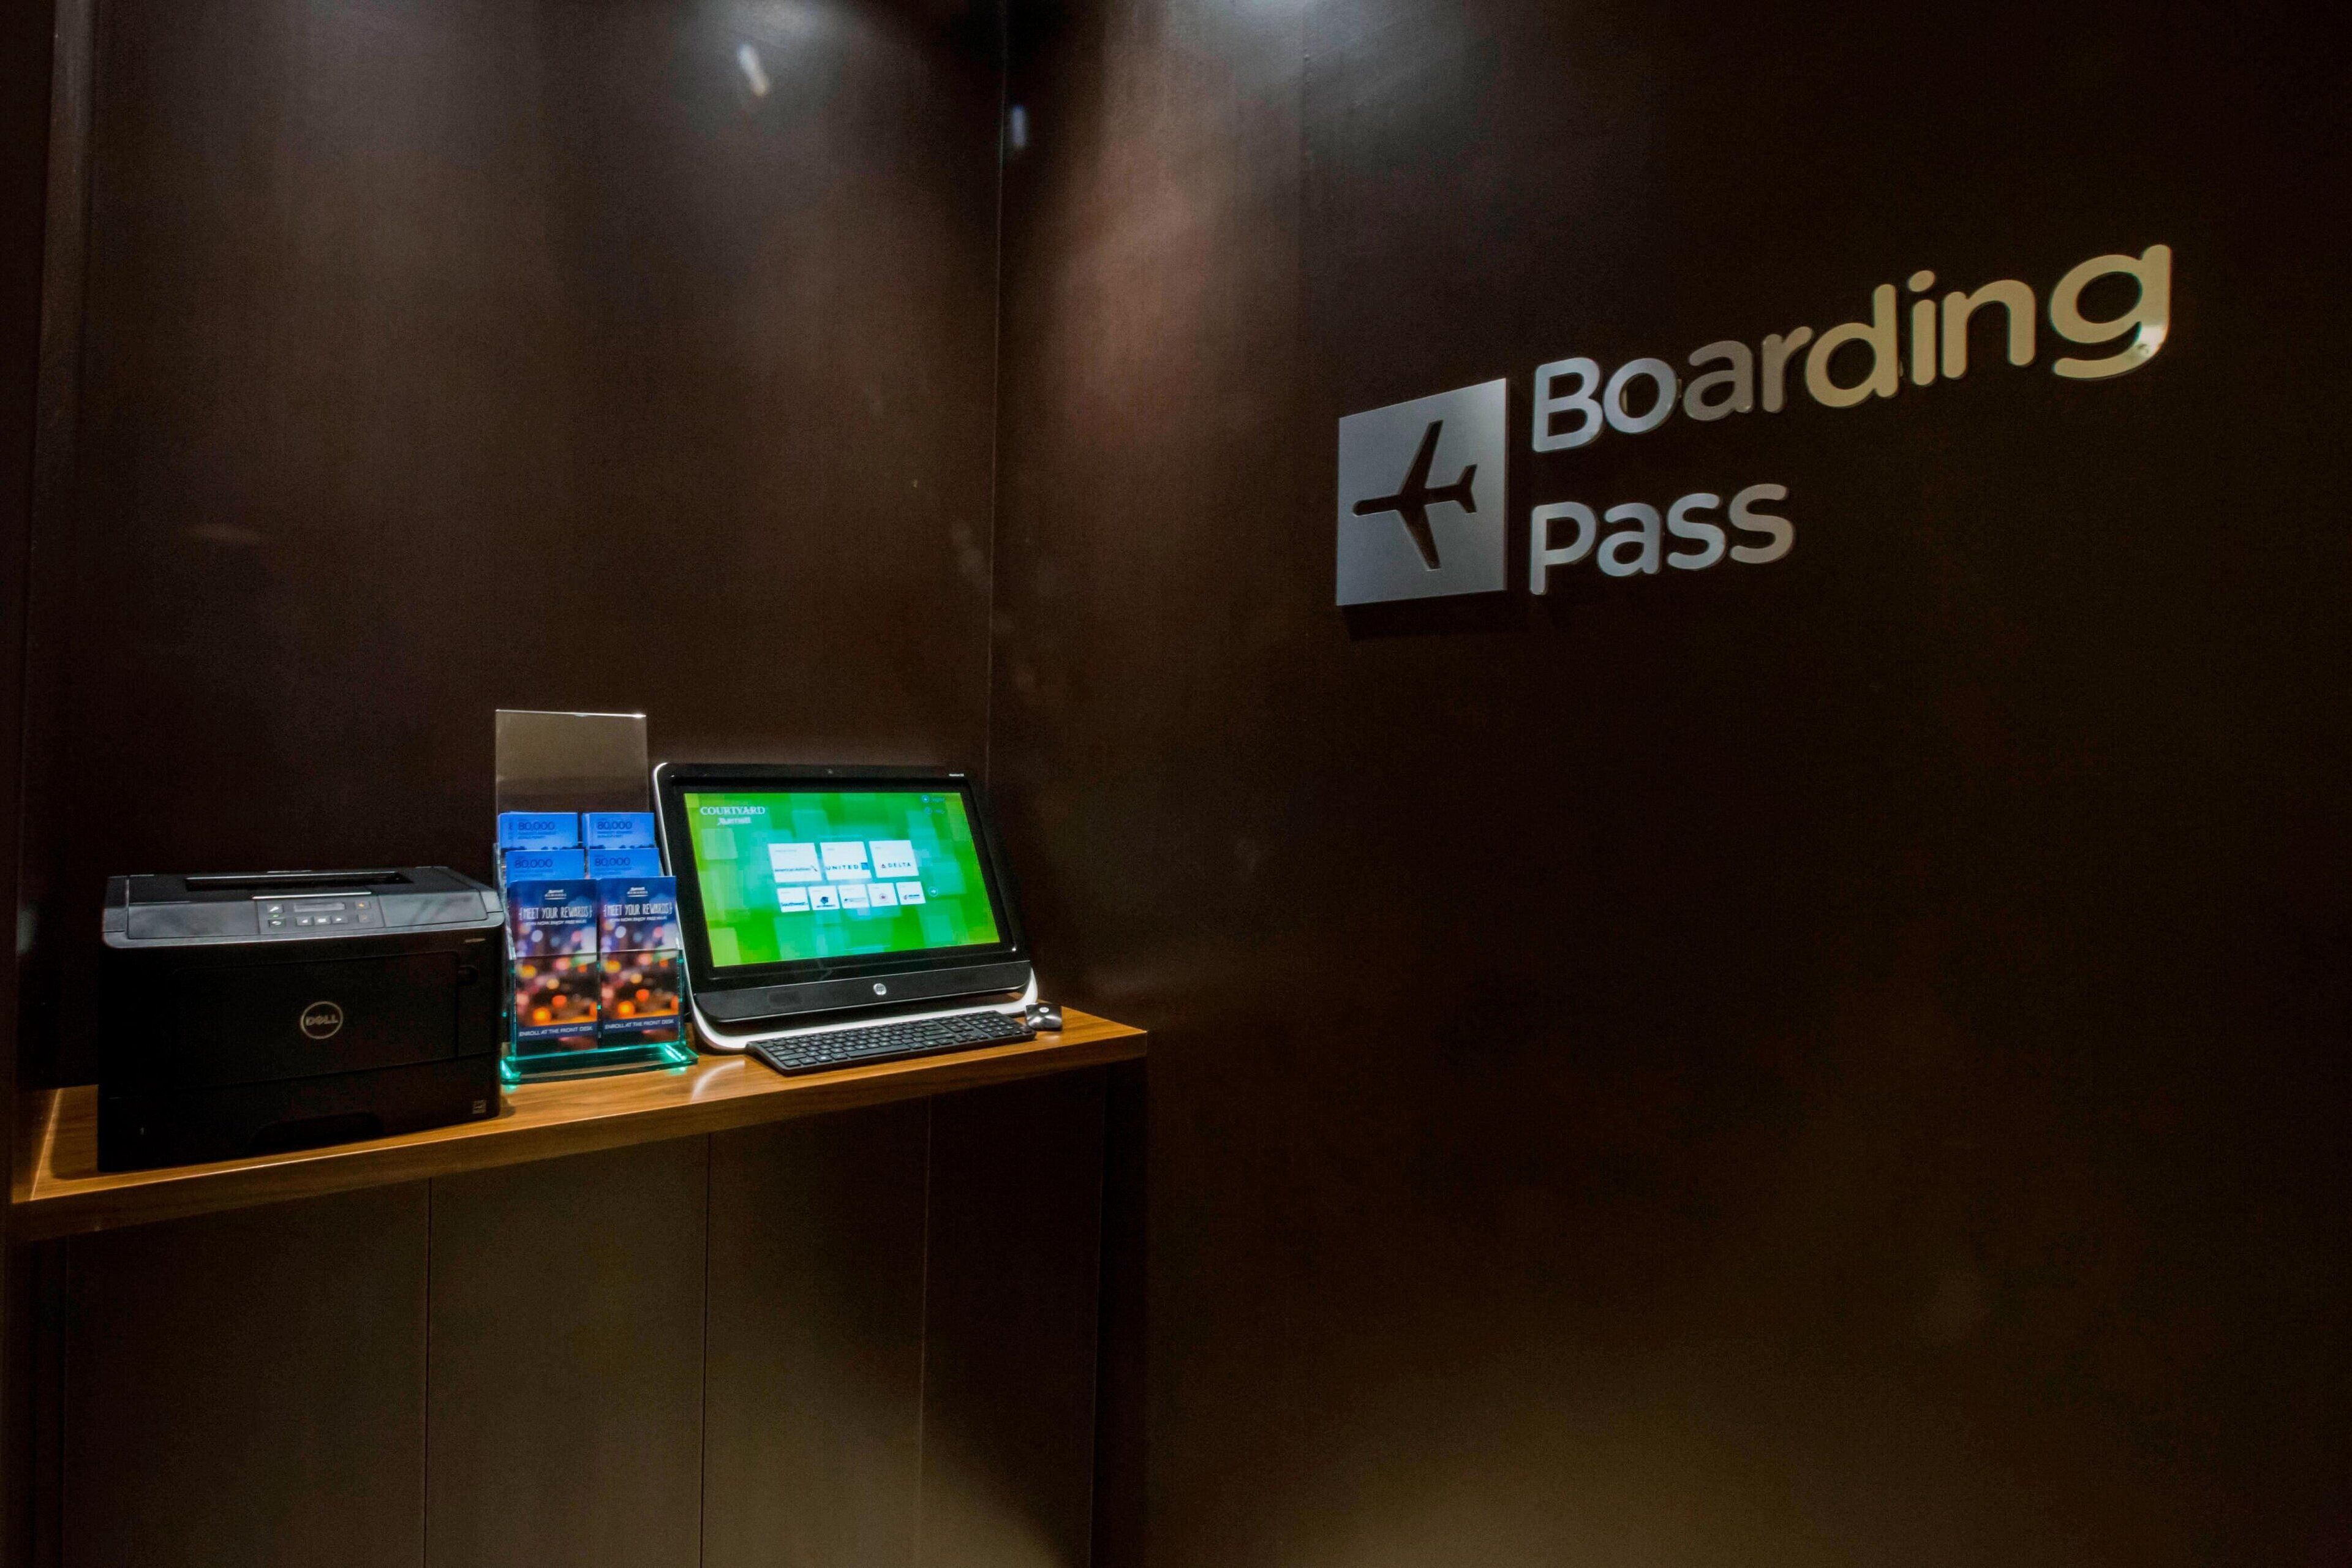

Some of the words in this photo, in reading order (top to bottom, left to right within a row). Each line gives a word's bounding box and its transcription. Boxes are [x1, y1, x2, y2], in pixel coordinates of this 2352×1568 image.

[1532, 243, 2171, 453] Boarding
[700, 806, 765, 815] COURTYARD
[517, 821, 556, 831] 80,000
[597, 821, 633, 830] 80,000
[514, 859, 553, 869] 80,000
[594, 858, 631, 867] 80,000
[542, 907, 558, 919] YOUR
[625, 903, 640, 916] YOUR
[306, 1014, 339, 1027] DELL
